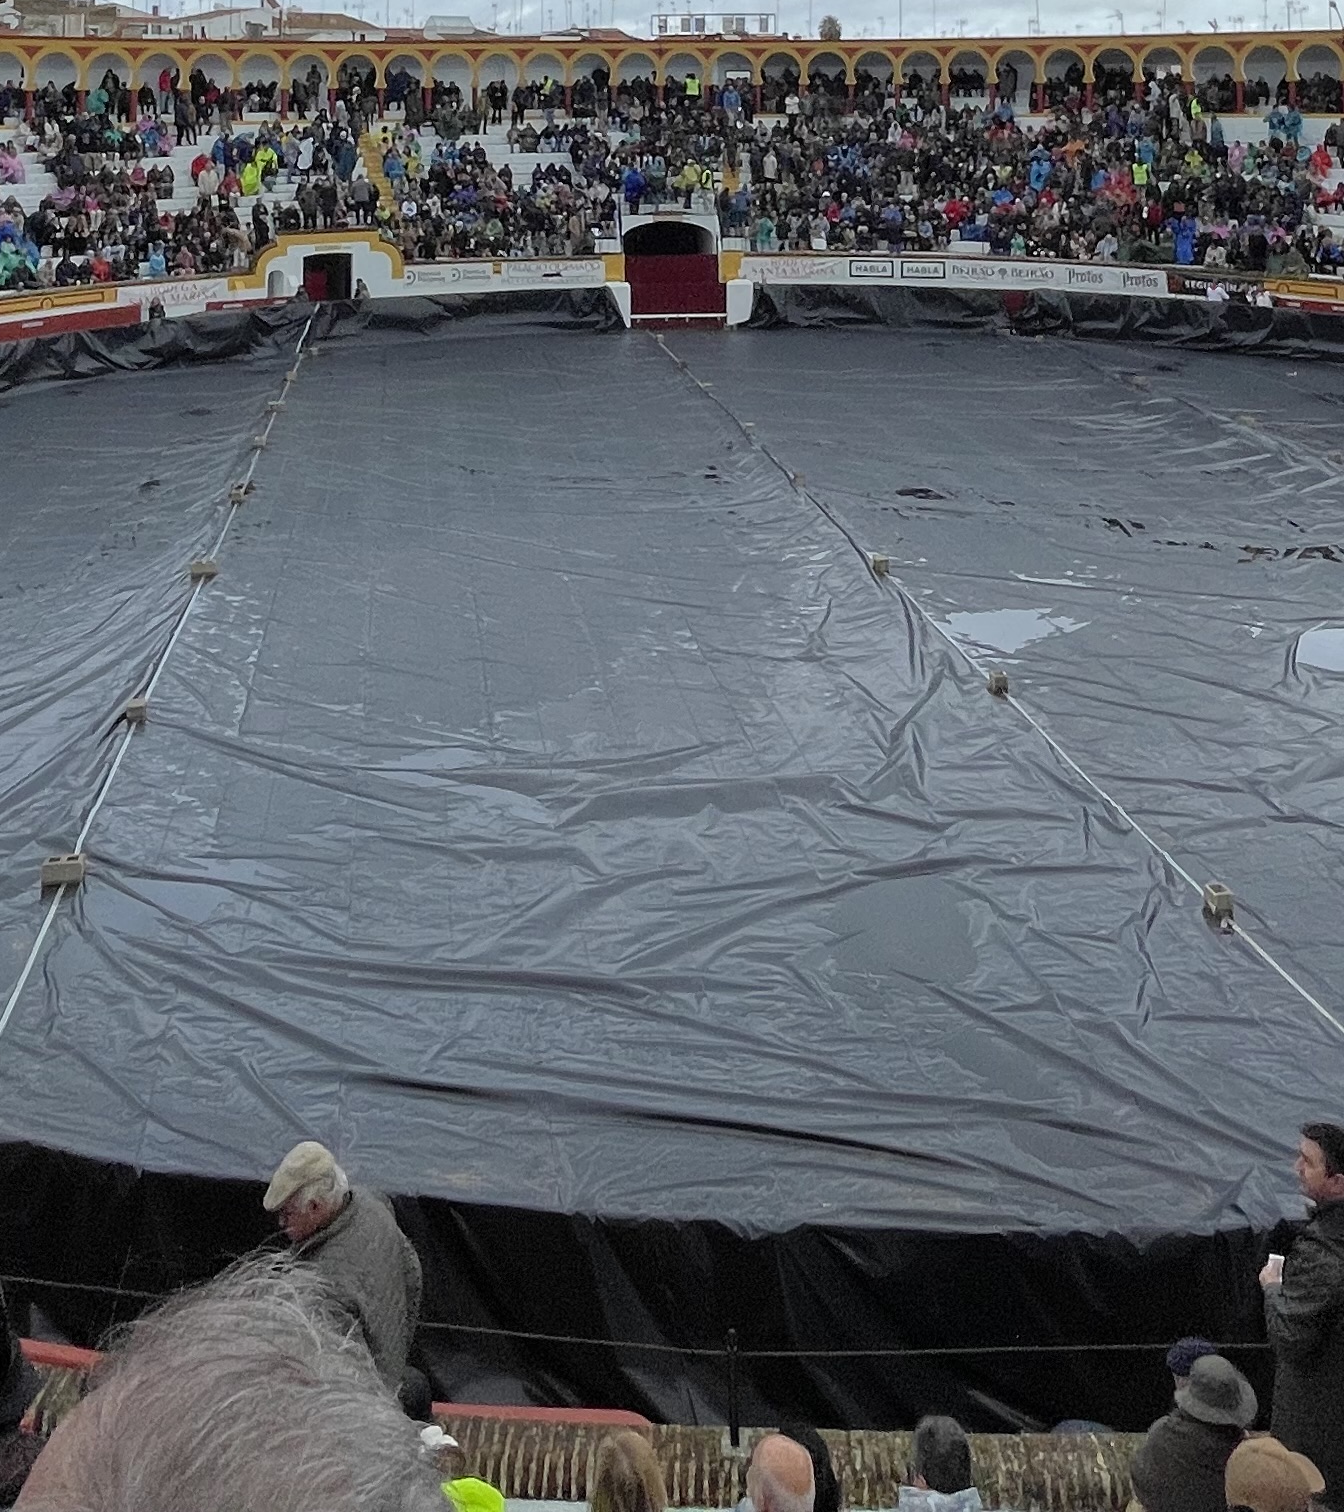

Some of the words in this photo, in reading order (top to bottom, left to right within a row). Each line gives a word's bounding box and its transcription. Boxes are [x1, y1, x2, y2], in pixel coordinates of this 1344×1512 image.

[855, 264, 888, 273] HABLA
[906, 266, 940, 274] HABLA
[1065, 267, 1104, 284] Protos
[1120, 271, 1159, 288] Protos
